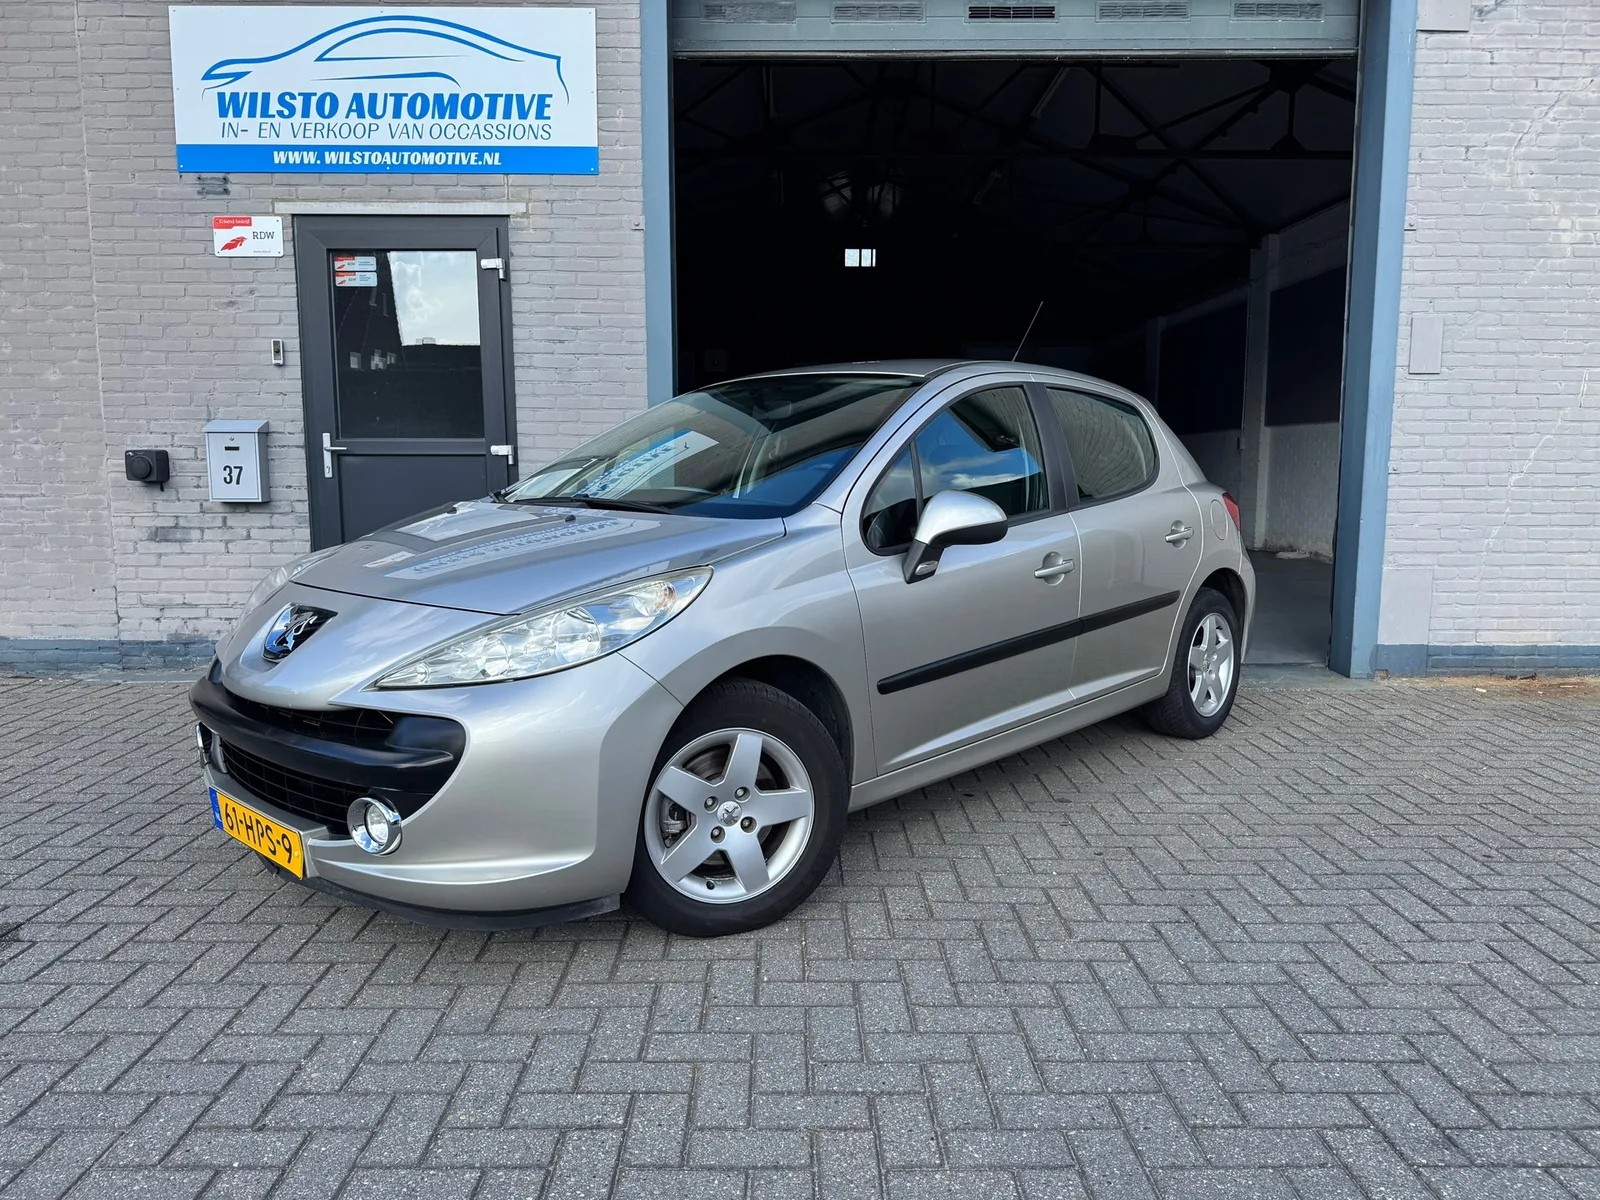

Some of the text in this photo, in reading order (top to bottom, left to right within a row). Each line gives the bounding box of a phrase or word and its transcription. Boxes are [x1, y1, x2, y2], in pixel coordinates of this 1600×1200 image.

[217, 92, 553, 120] WILSTO AUTOMOTIVE
[221, 122, 552, 140] IN- EN VERKOOP VAN OCCASSIONS
[252, 231, 275, 240] RDW
[223, 465, 243, 485] 37
[225, 803, 292, 864] 61-HPS-9
